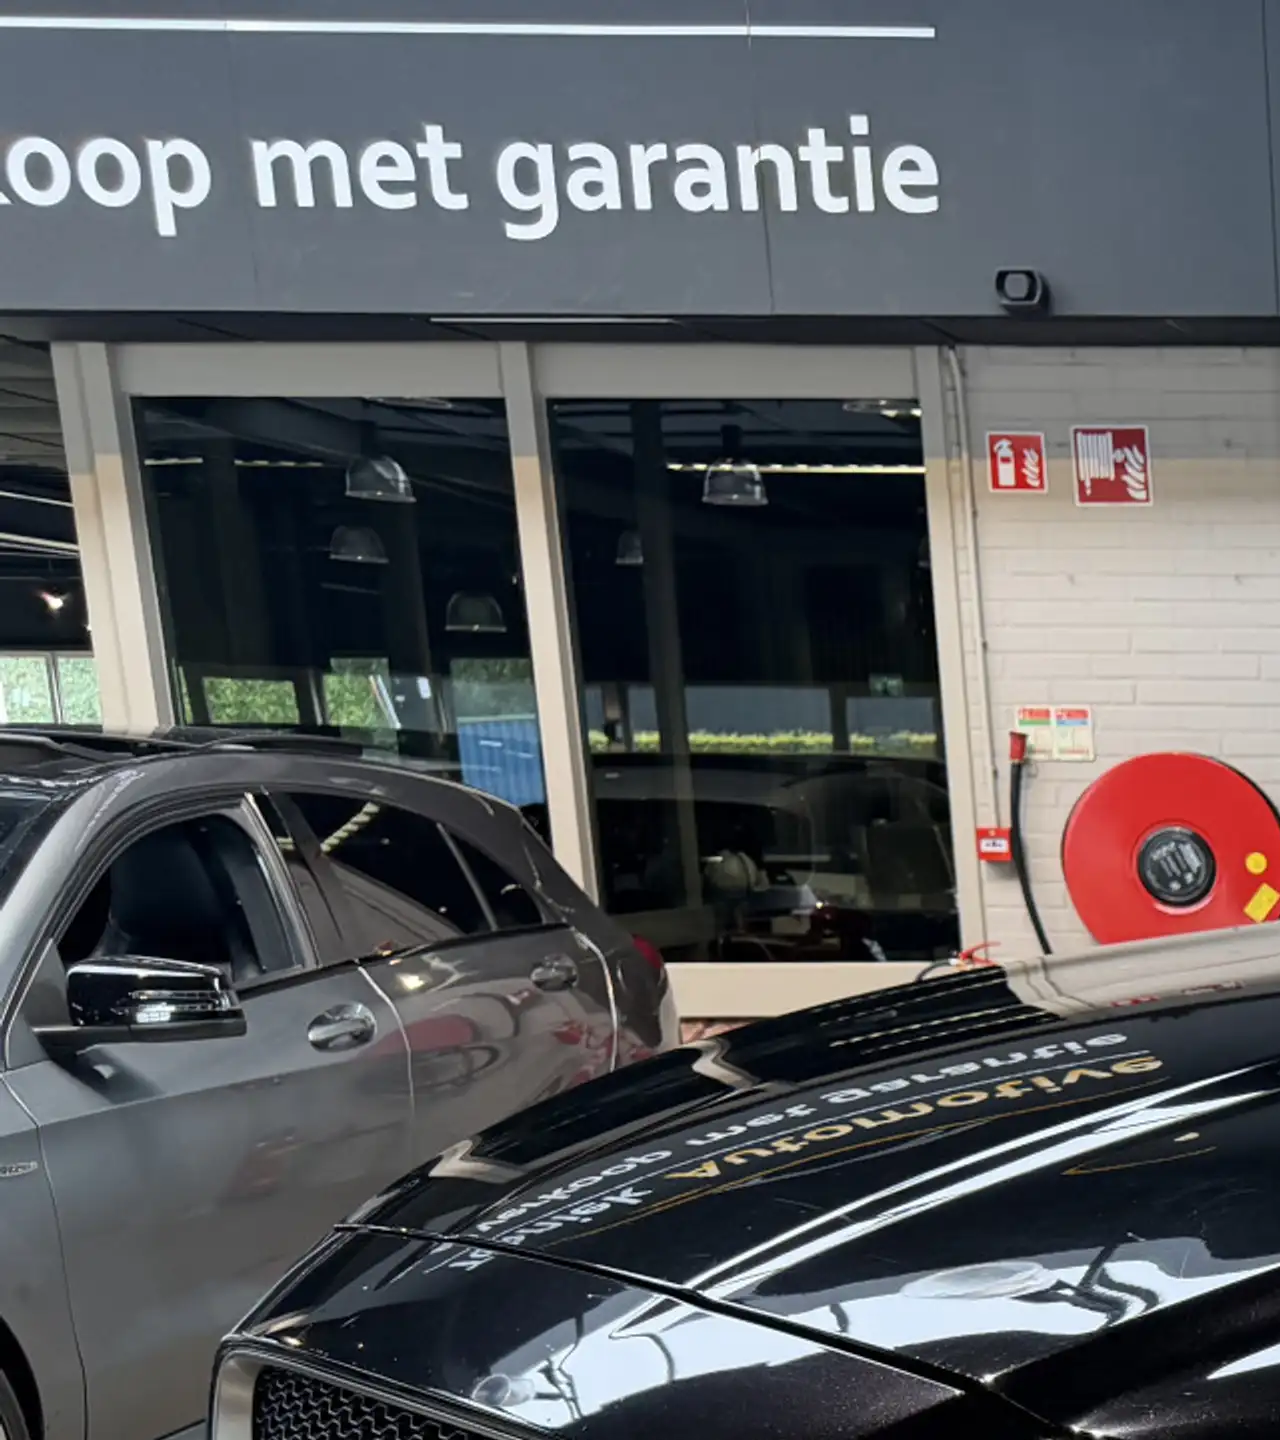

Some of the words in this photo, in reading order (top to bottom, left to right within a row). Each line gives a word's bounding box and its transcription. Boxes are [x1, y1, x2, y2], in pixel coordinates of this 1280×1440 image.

[0, 136, 212, 237] oop
[250, 123, 470, 210] met
[496, 113, 941, 241] garantie
